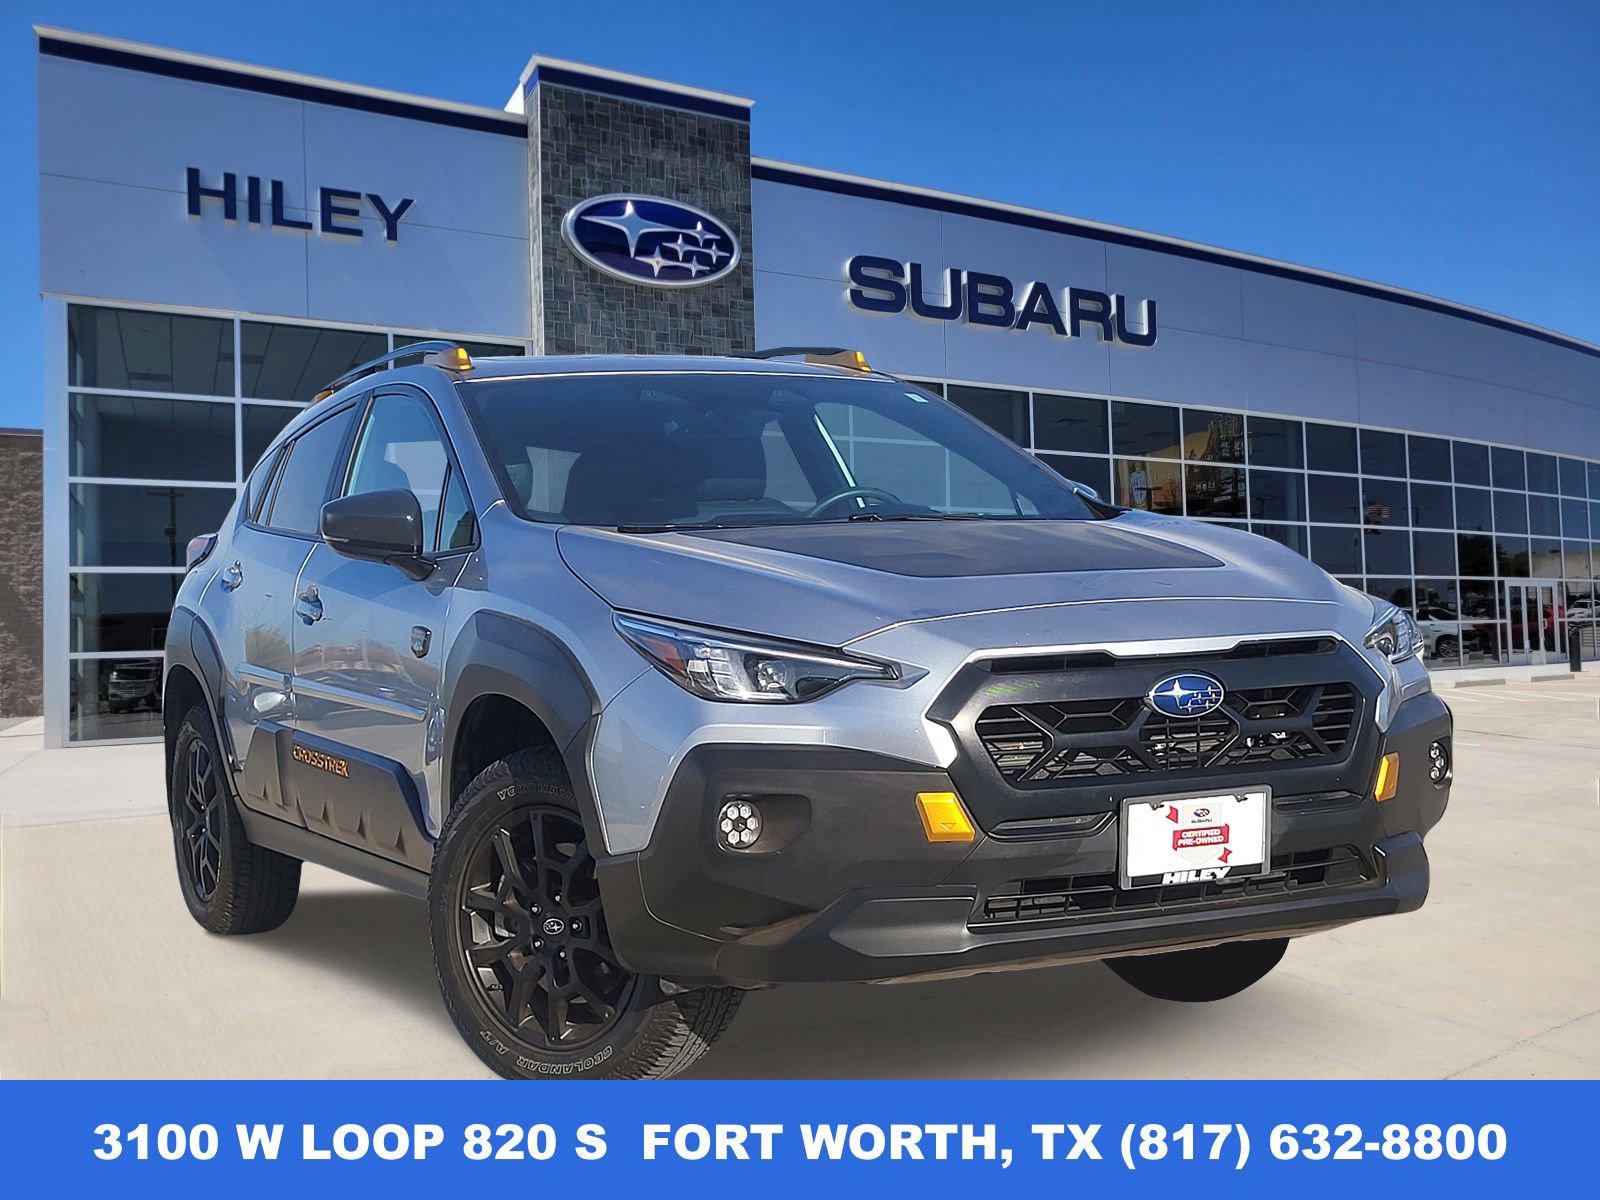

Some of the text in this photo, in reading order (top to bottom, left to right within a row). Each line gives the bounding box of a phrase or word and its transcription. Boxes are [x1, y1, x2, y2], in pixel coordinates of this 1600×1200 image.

[186, 166, 414, 242] HILEY
[847, 254, 1158, 347] SUBARU
[292, 744, 350, 778] CROSSTREK
[1177, 835, 1225, 847] PRE-OWNED
[1181, 828, 1222, 839] CERTIFIED
[1161, 866, 1232, 886] HILEY
[479, 1030, 613, 1075] GEOLANDAR A/T
